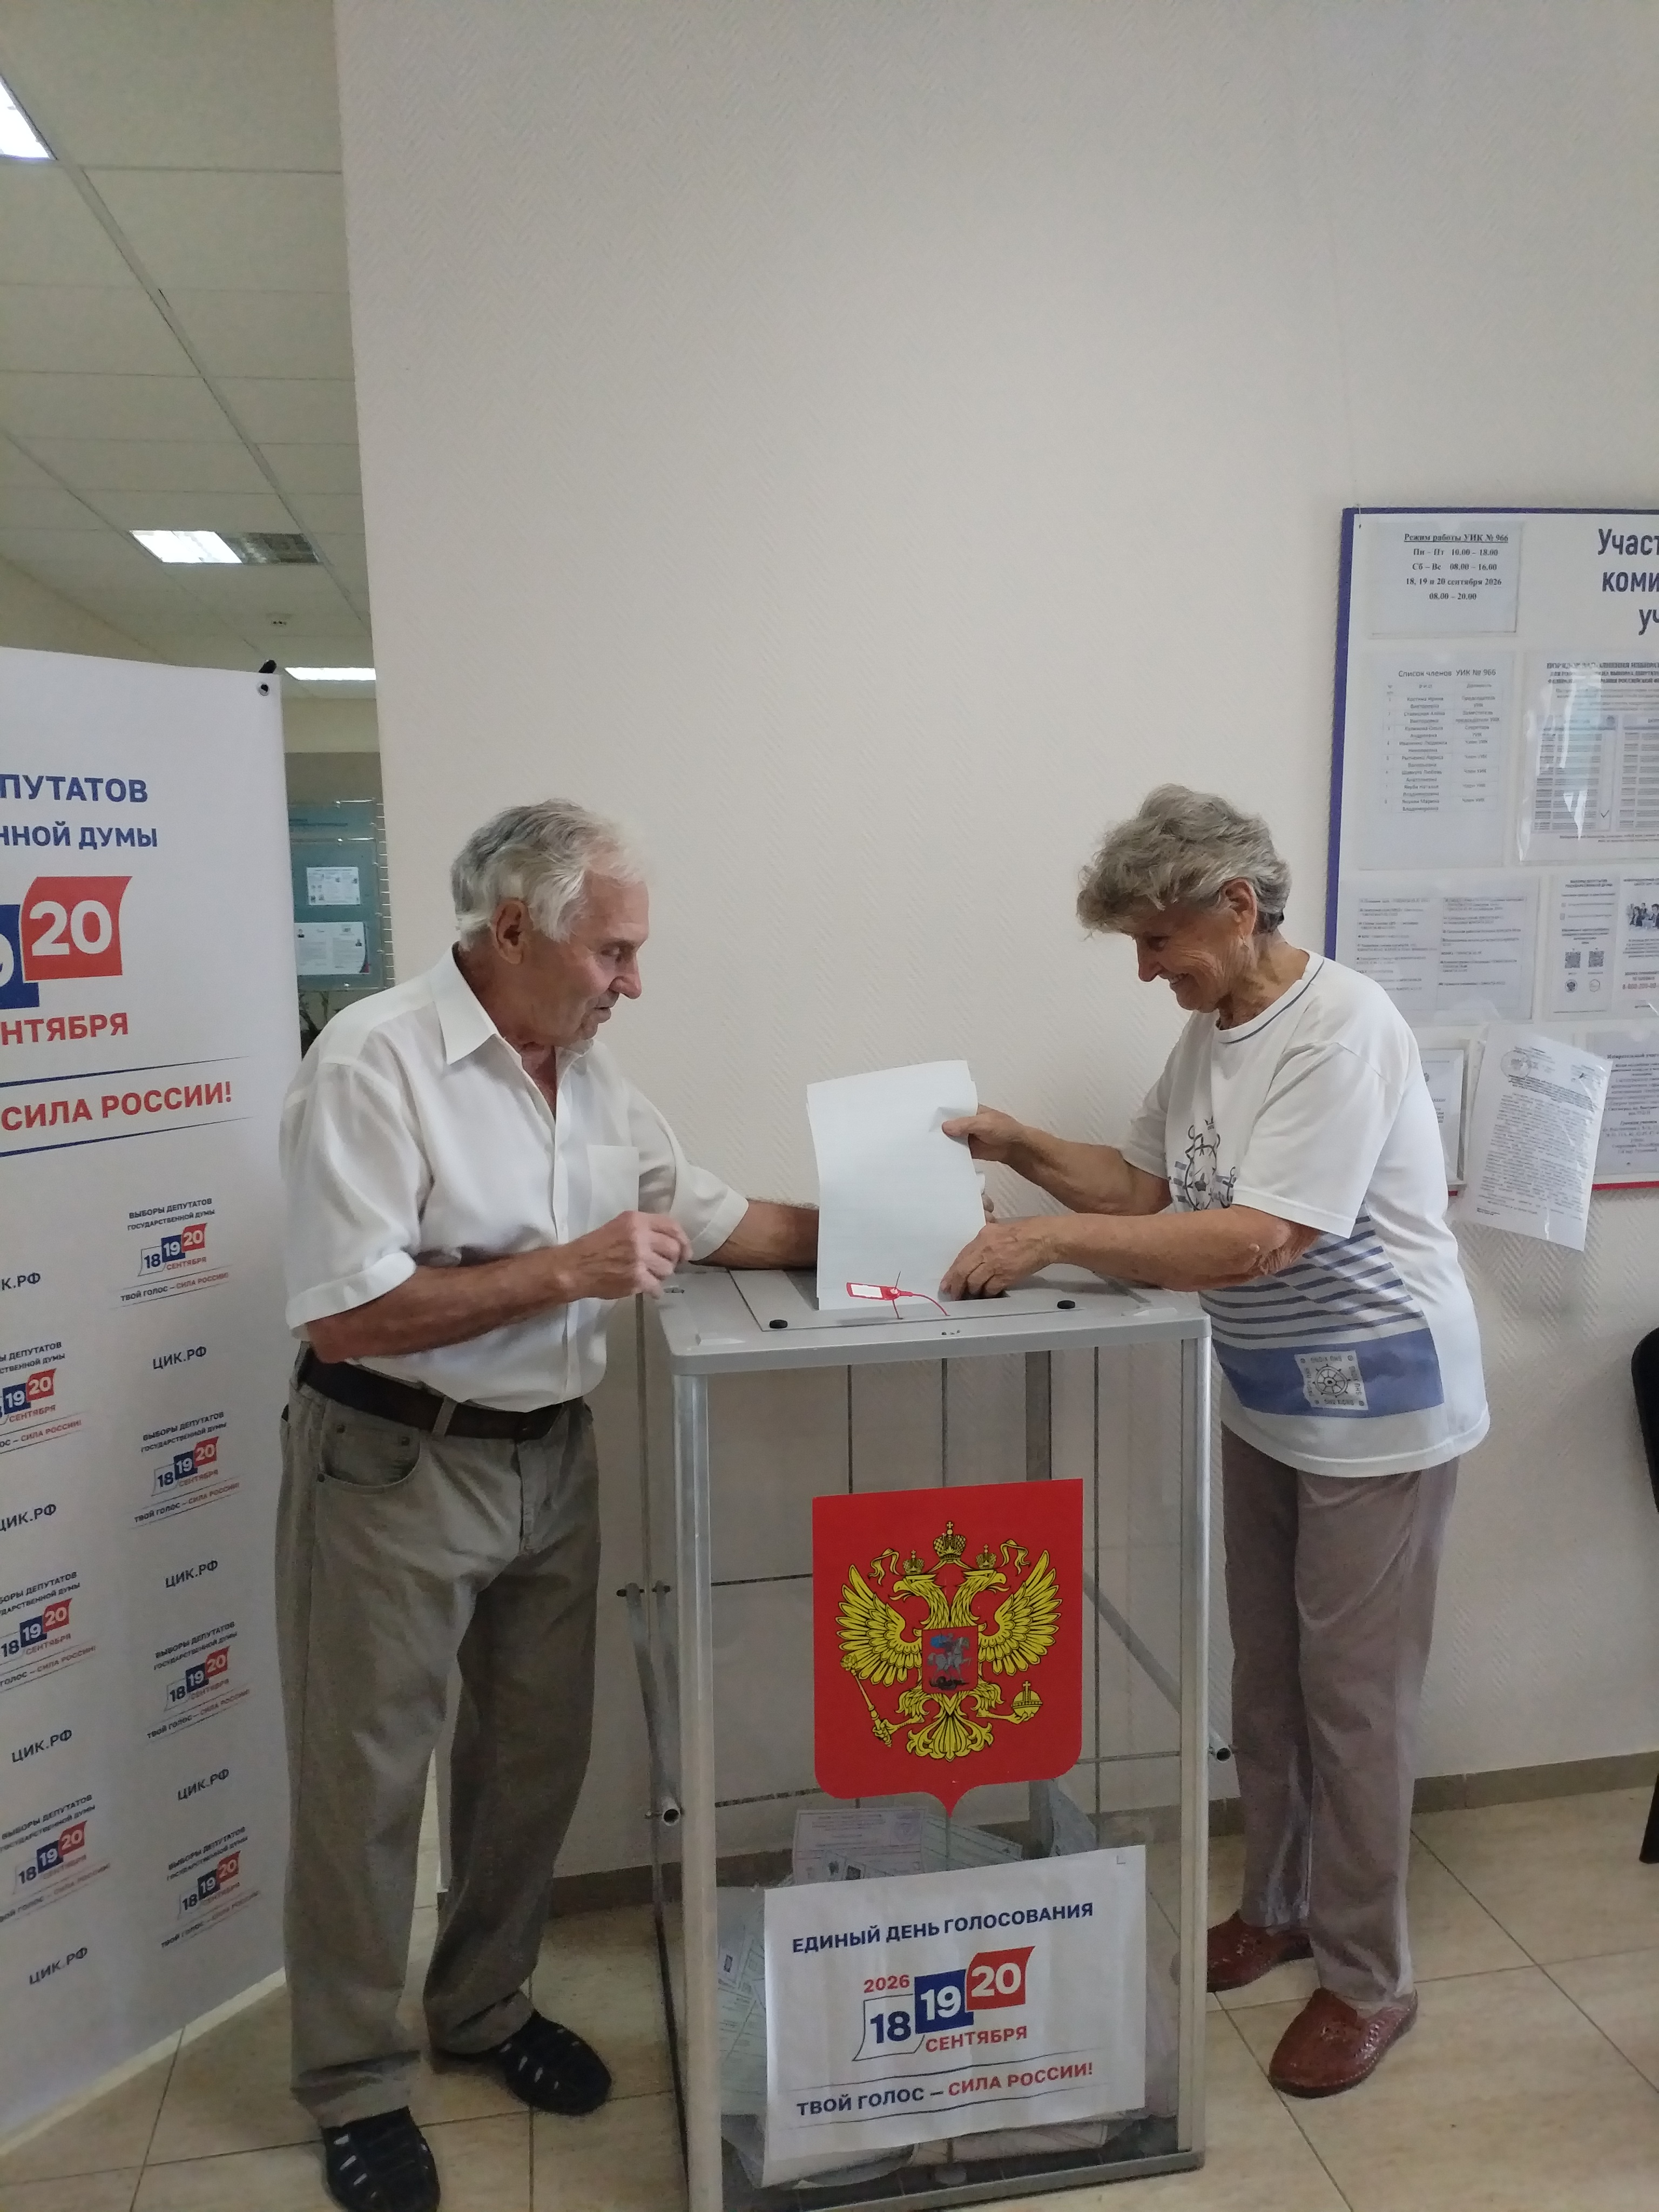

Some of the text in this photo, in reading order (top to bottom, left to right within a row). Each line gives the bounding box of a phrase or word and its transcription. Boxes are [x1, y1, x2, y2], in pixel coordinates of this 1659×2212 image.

[1433, 534, 1461, 542] работы
[1447, 578, 1482, 586] сентября
[78, 827, 158, 849] ДУМЫ
[29, 900, 112, 957] 20
[1, 1081, 232, 1131] СИЛА РОССИИ!
[127, 1209, 215, 1230] ГОСУДАРСТВЕННОЙ ДУМЫ
[129, 1198, 212, 1218] ВЫБОРЫ ДЕПУТАТОВ
[144, 1230, 203, 1268] 18 19 20
[166, 1257, 206, 1270] СЕНТЯБРЯ
[1, 1272, 41, 1290] К.РФ
[120, 1290, 141, 1301] ТВОЙ
[143, 1285, 167, 1297] ГОЛОС
[176, 1279, 195, 1289] СИЛА
[9, 1342, 62, 1361] ДЕПУТАТОВ
[42, 1353, 65, 1364] ДУМЫ
[153, 1346, 206, 1370] ЦИК.РФ
[5, 1377, 52, 1408] 19 20
[9, 1405, 56, 1422] СЕНТЯБРЯ
[143, 1412, 224, 1441] ВЫБОРЫ ДЕПУТАТОВ
[21, 1429, 43, 1441] СИЛА
[45, 1420, 81, 1434] РОССИИ!
[141, 1422, 227, 1452] ГОСУДАРСТВЕННОЙ ДУМЫ
[158, 1444, 214, 1487] 18 19 20
[179, 1469, 218, 1487] СЕНТЯБРЯ
[134, 1510, 154, 1523] ТВОЙ
[156, 1503, 180, 1514] ГОЛОС
[188, 1494, 207, 1505] СИЛА
[26, 1572, 77, 1595] ДЕПУТАТОВ
[166, 1560, 218, 1588] ЦИК.РФ
[58, 1583, 80, 1595] ДУМЫ
[1, 1607, 67, 1657] 18 19 20
[26, 1633, 71, 1655] СЕНТЯБРЯ
[156, 1621, 234, 1658] ВЫБОРЫ ДЕПУТАТОВ
[37, 1660, 59, 1673] СИЛА
[170, 1654, 226, 1702] 18 19 20
[147, 1725, 166, 1738] ТВОЙ
[168, 1715, 192, 1729] ГОЛОС
[12, 1729, 72, 1763] ЦИК.РФ
[178, 1769, 229, 1800] ЦИК.РФ
[1, 1795, 92, 1840] ВЫБОРЫ ДЕПУТАТОВ
[18, 1830, 82, 1884] 18 19 20
[182, 1894, 197, 1910] 18
[199, 1877, 215, 1893] 19
[219, 1859, 237, 1877] 20
[792, 1903, 1093, 1954] ЕДИНЫЙ ДЕНЬ ГОЛОСОВАНИЯ
[29, 1946, 87, 1985] ЦИК.РФ
[864, 1974, 910, 1993] 2026
[871, 1963, 1021, 2043] 18 19 20
[926, 2026, 1028, 2053] СЕНТЯБРЯ
[797, 2094, 852, 2116] ТВОЙ
[859, 2088, 924, 2111] ГОЛОС
[948, 2076, 1002, 2096] СИЛА
[1007, 2062, 1093, 2087] РОССИИ!
